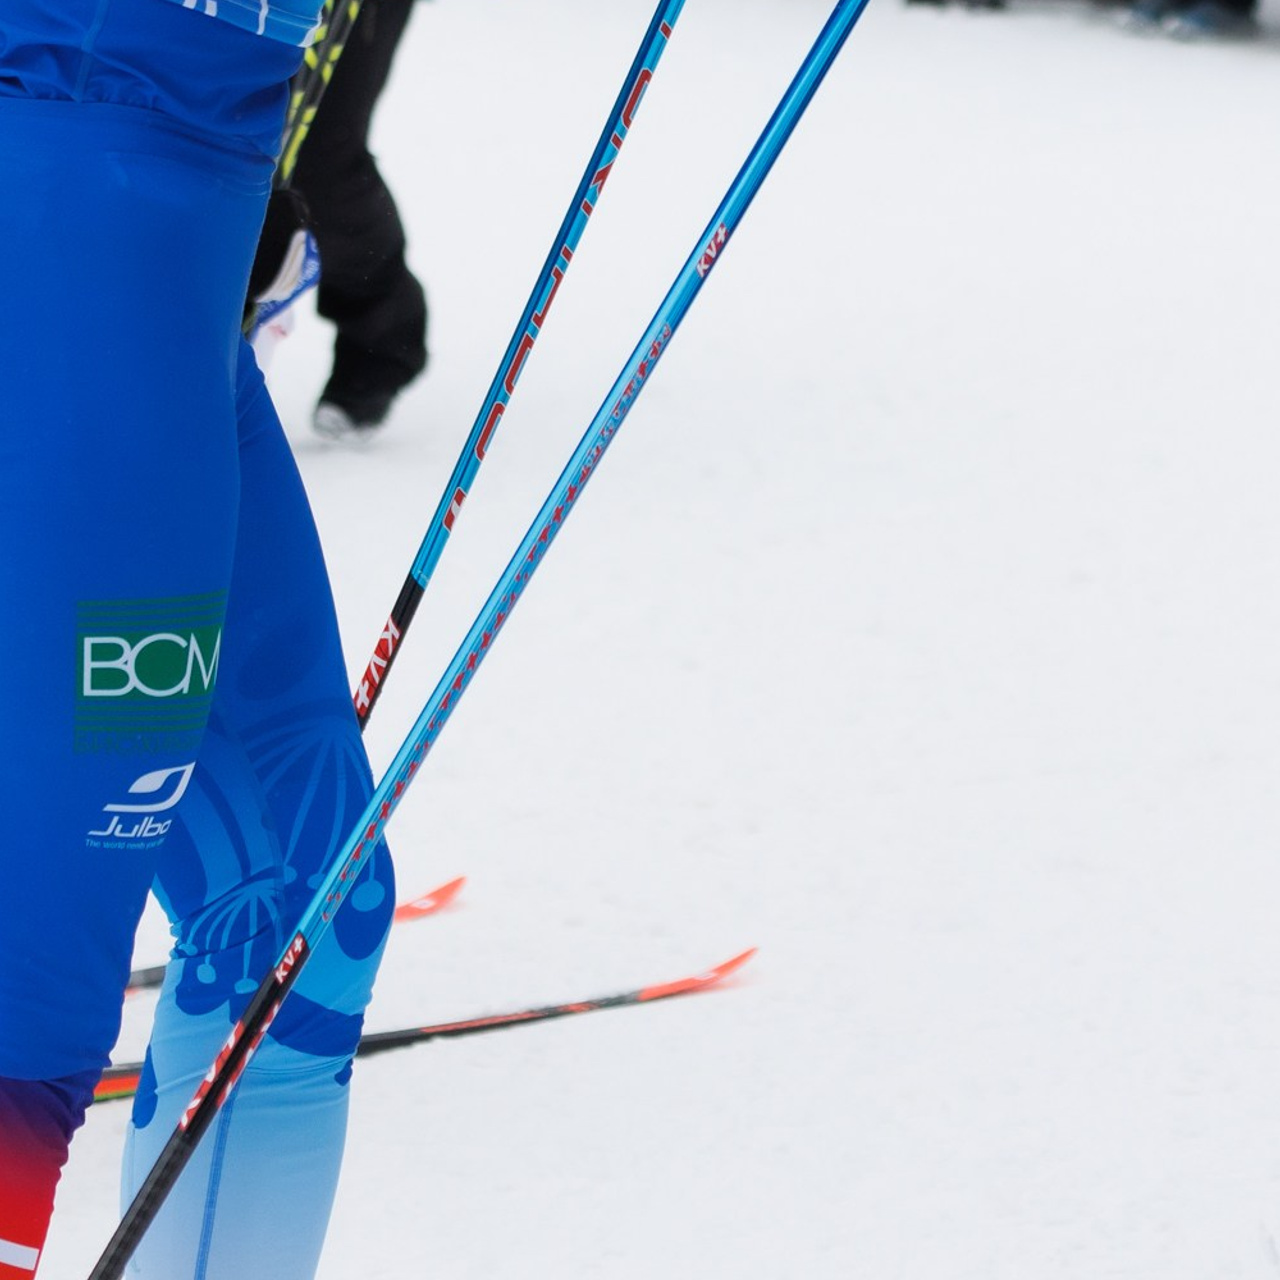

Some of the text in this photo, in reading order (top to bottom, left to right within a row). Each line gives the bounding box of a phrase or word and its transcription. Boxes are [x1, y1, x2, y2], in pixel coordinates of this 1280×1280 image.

[696, 226, 726, 278] KV+
[356, 617, 402, 711] KV+
[87, 815, 172, 838] Julbo
[273, 937, 304, 984] KV+
